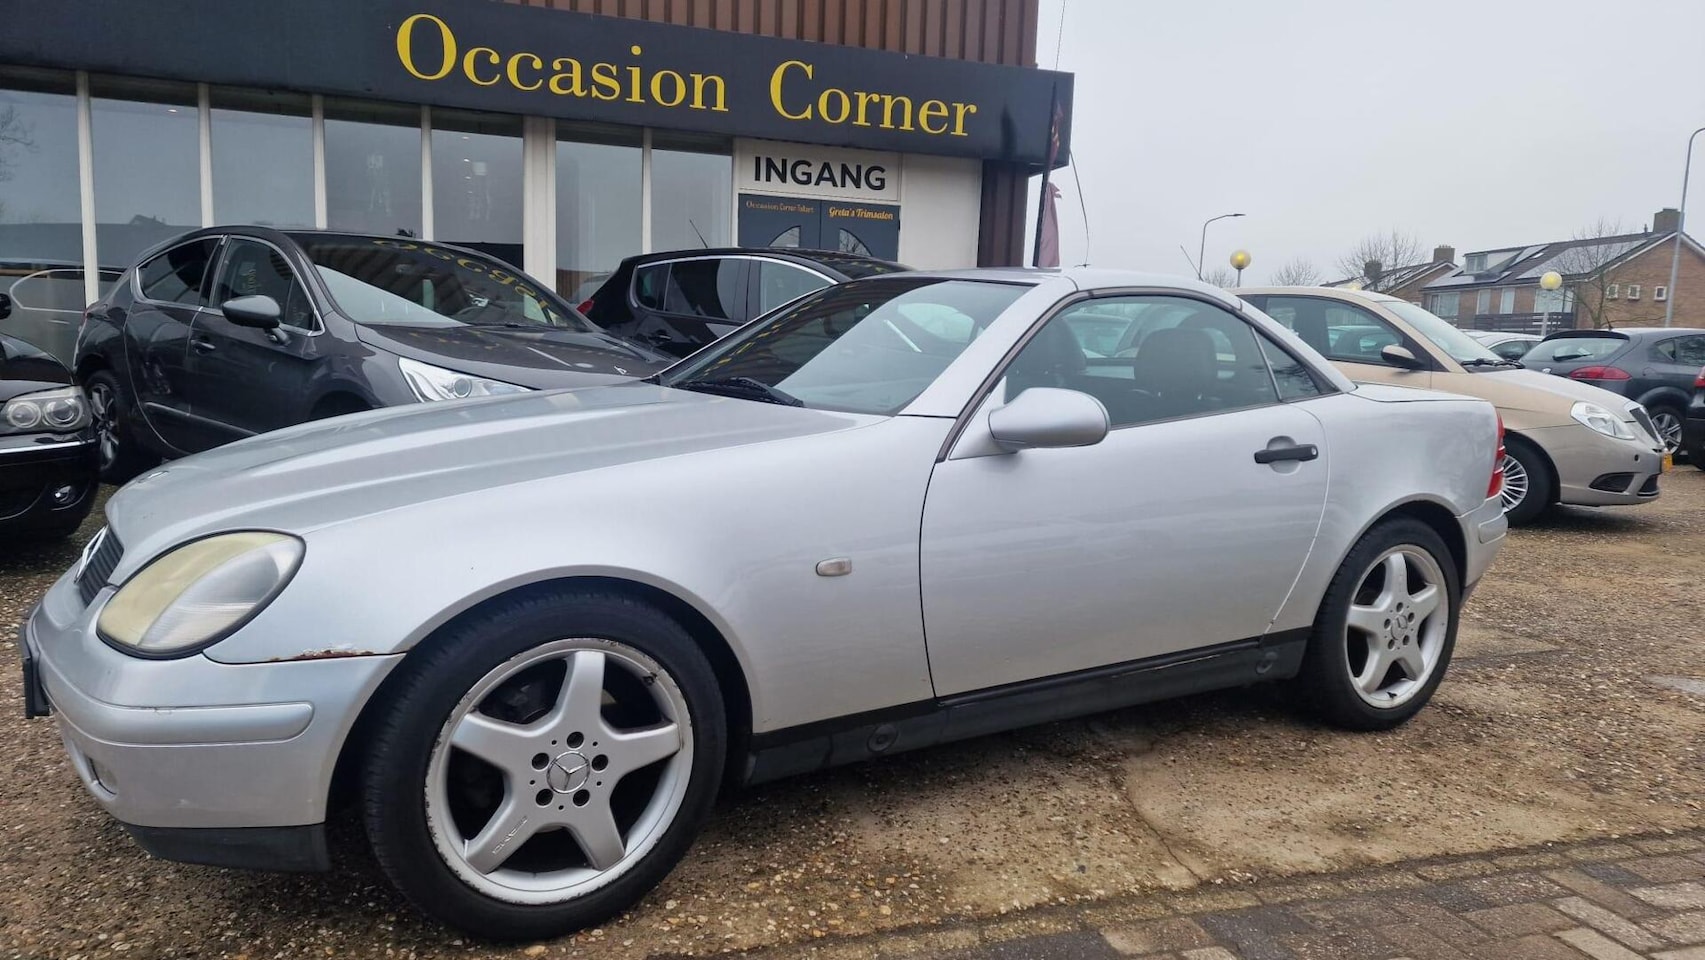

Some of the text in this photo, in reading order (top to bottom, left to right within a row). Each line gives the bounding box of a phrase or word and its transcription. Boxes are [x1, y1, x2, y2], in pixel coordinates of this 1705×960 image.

[396, 13, 977, 137] Occasion Corner
[754, 156, 886, 191] INGANG
[829, 206, 894, 220] Greta's Trimsalon
